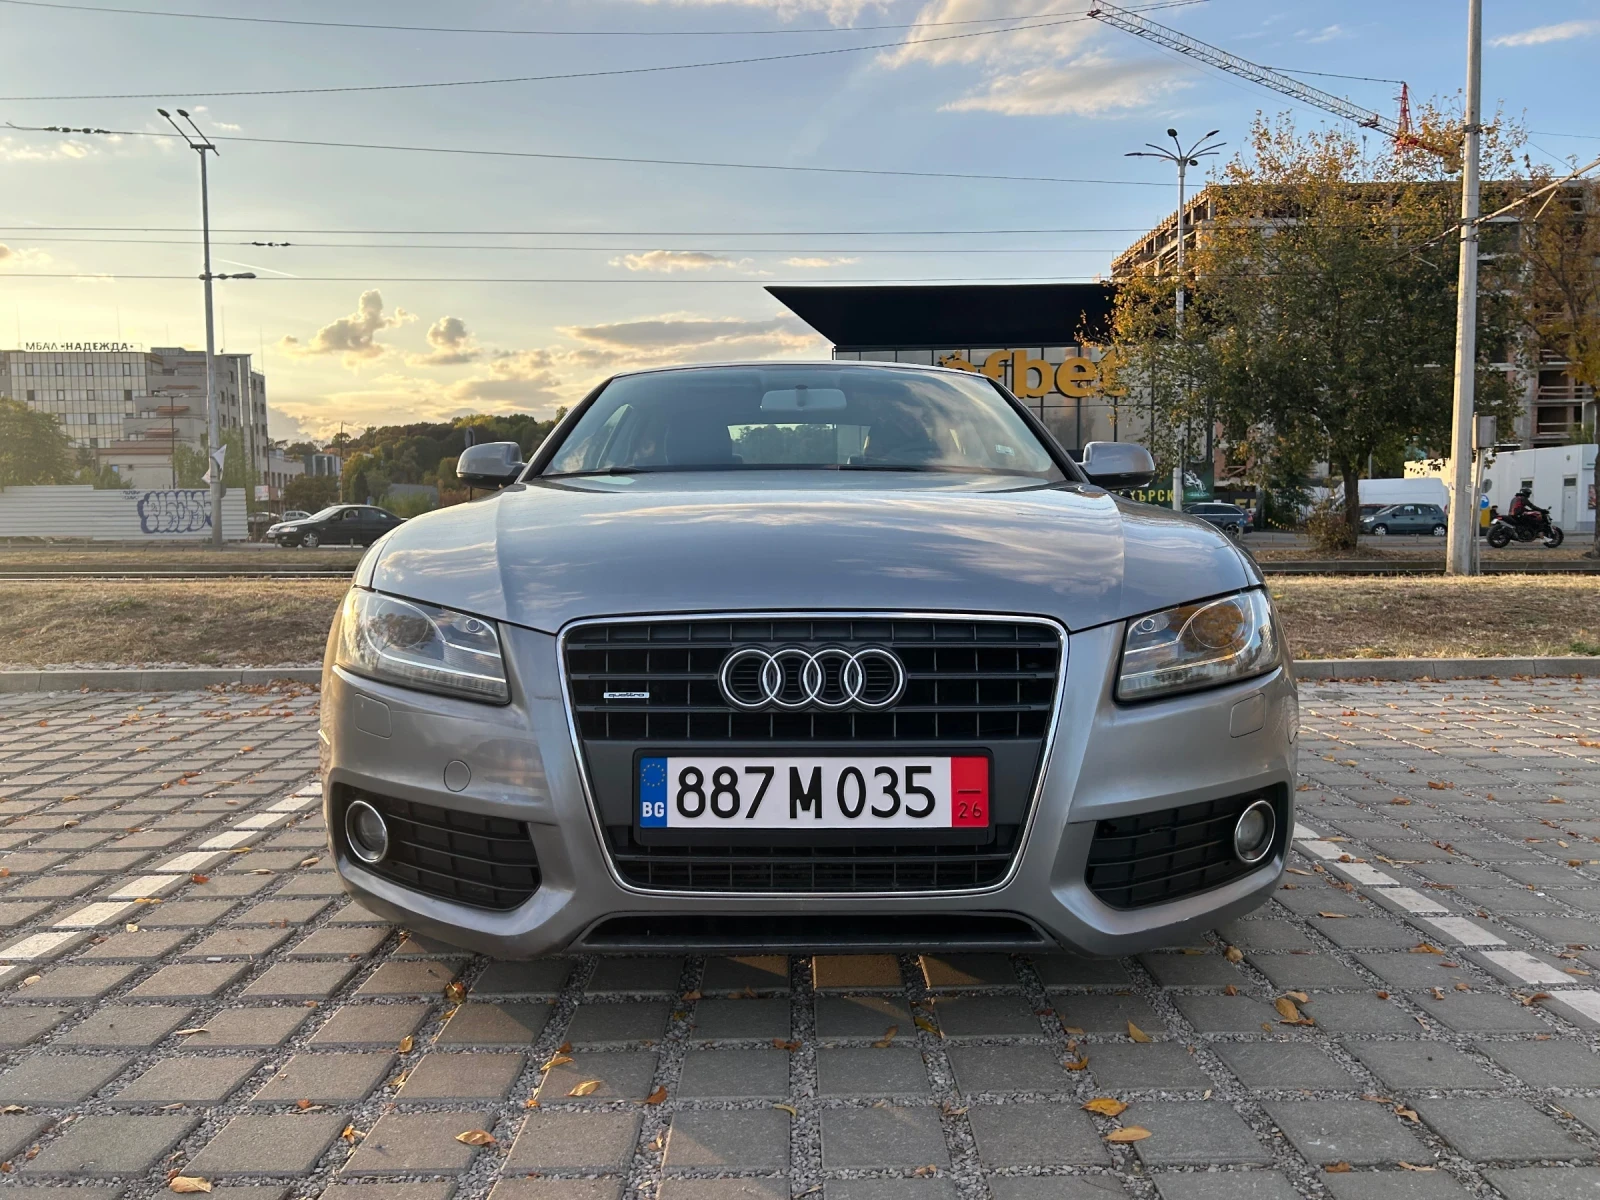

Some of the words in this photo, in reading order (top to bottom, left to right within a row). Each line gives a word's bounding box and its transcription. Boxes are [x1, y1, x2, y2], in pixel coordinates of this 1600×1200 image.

[25, 342, 58, 351] МБАЛ
[676, 766, 775, 819] 887
[789, 766, 823, 819] M
[836, 766, 936, 819] 035
[642, 801, 665, 818] BG
[958, 801, 982, 819] 26
